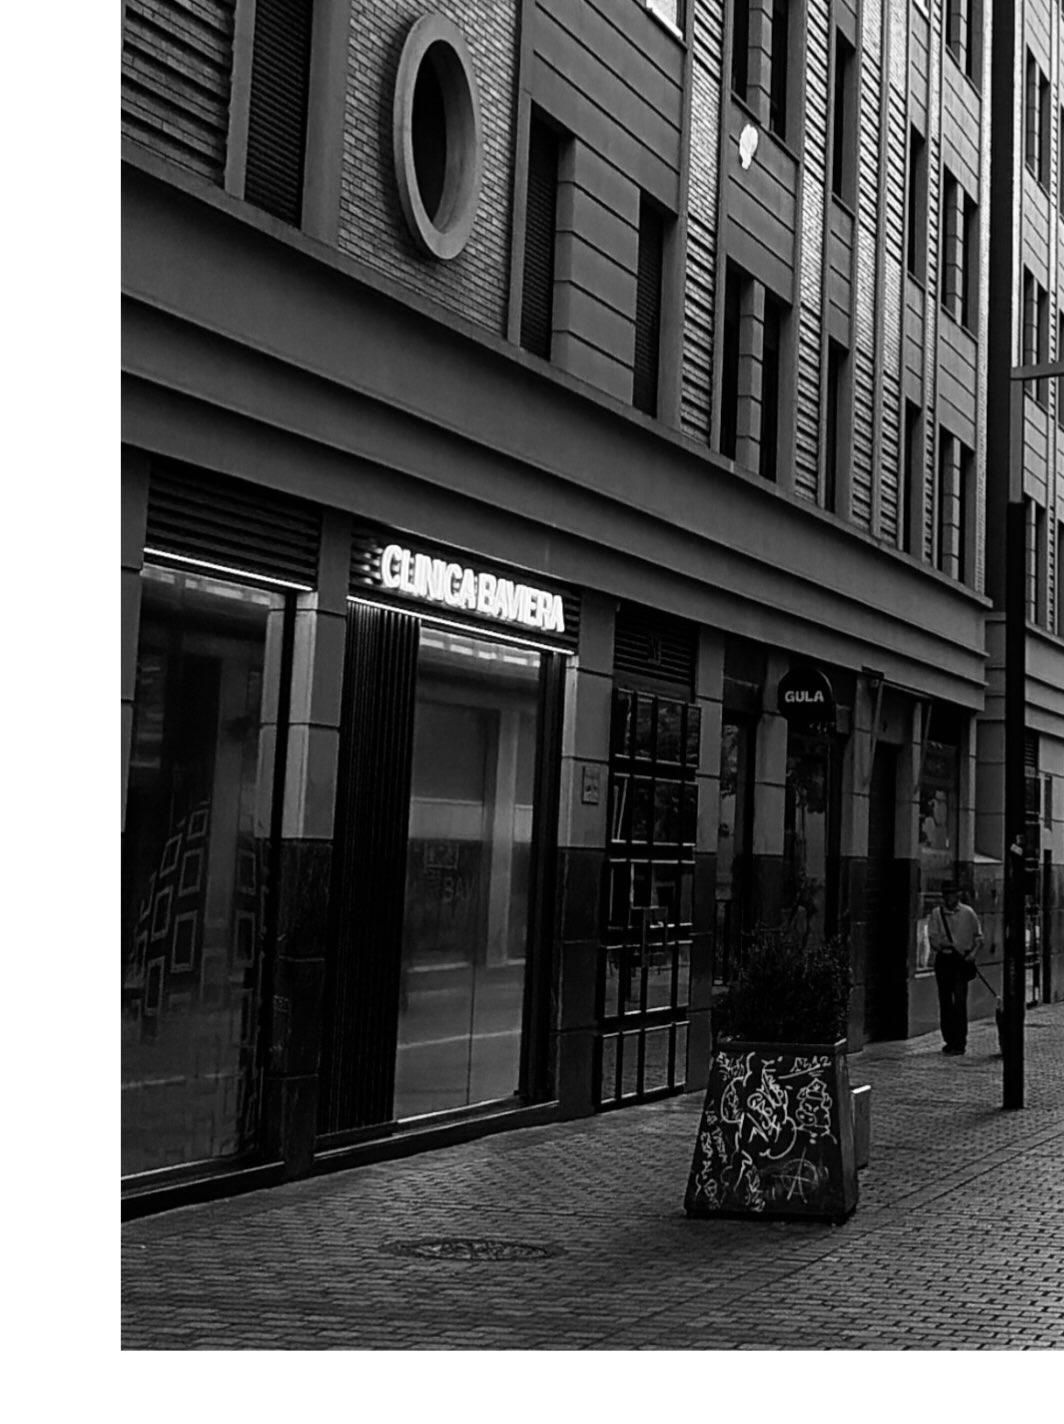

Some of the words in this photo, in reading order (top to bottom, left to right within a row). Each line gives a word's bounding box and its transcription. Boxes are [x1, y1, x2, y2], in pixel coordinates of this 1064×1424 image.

[381, 544, 476, 609] CLINICA
[477, 572, 566, 632] BAVIERA
[784, 690, 825, 703] GULA
